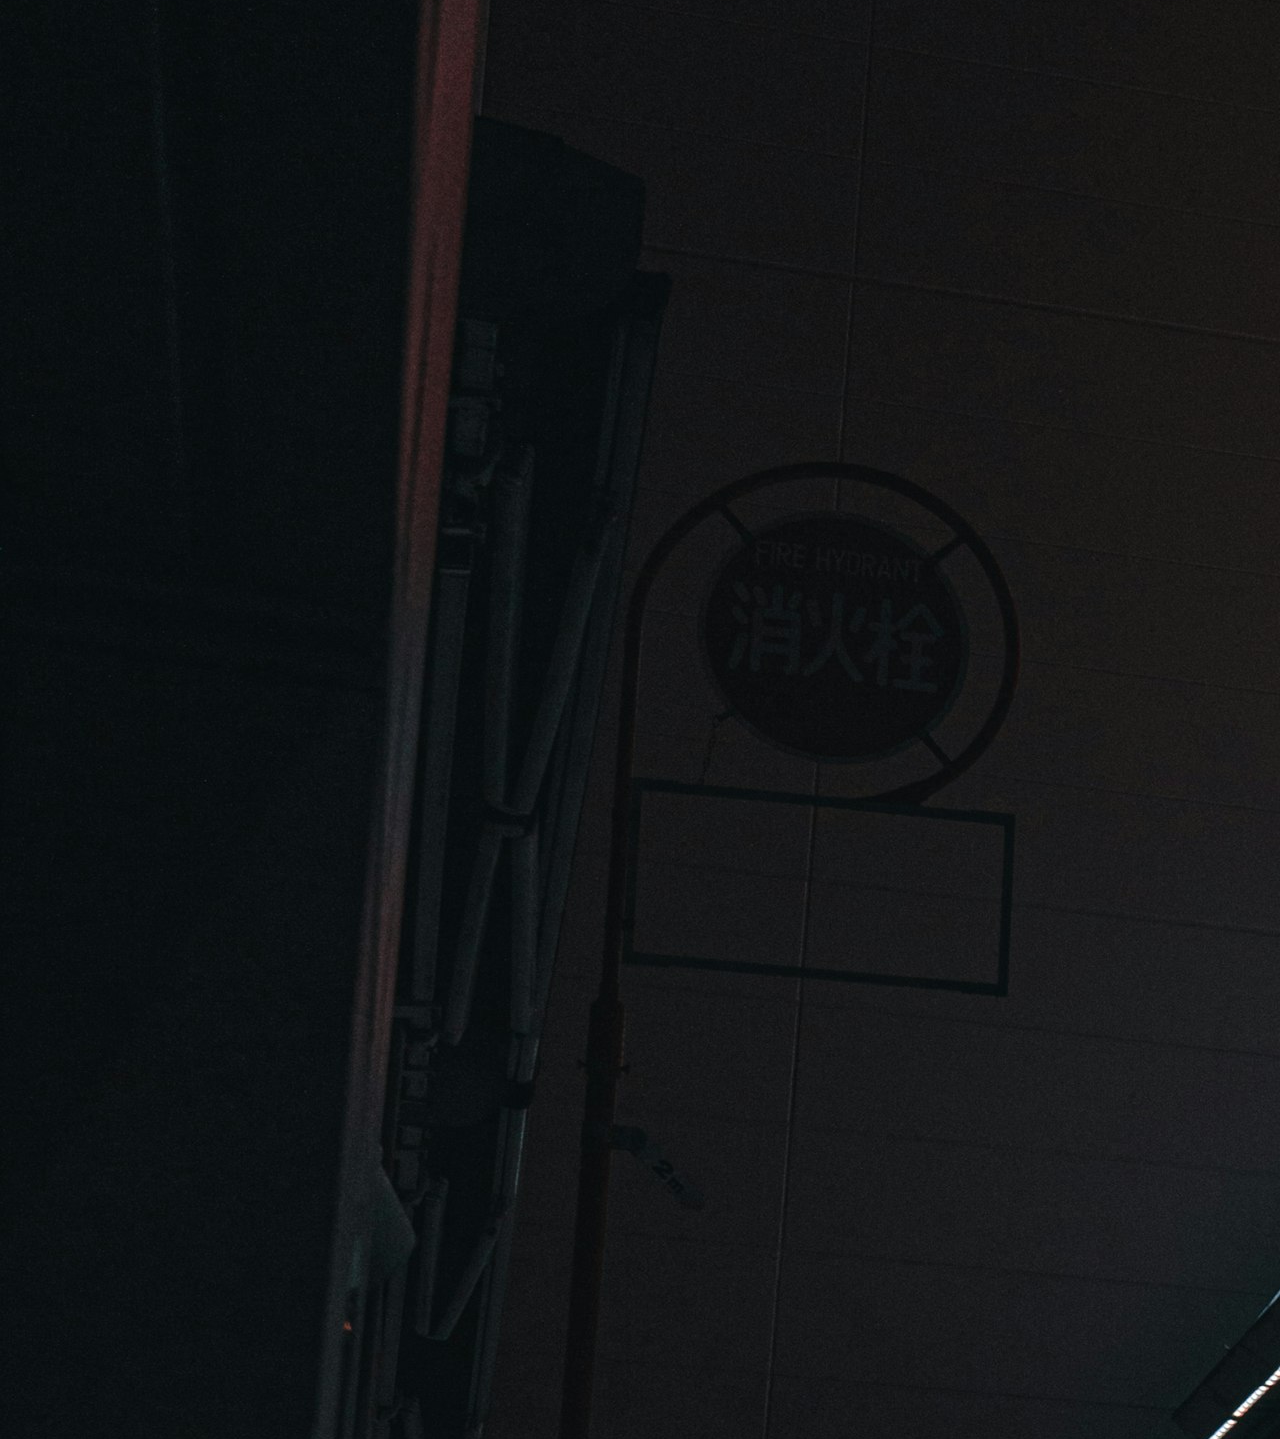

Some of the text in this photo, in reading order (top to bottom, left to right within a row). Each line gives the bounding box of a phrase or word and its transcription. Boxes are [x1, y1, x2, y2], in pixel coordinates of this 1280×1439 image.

[755, 540, 923, 584] FIRE HYDRANT
[727, 580, 946, 693] 消火栓
